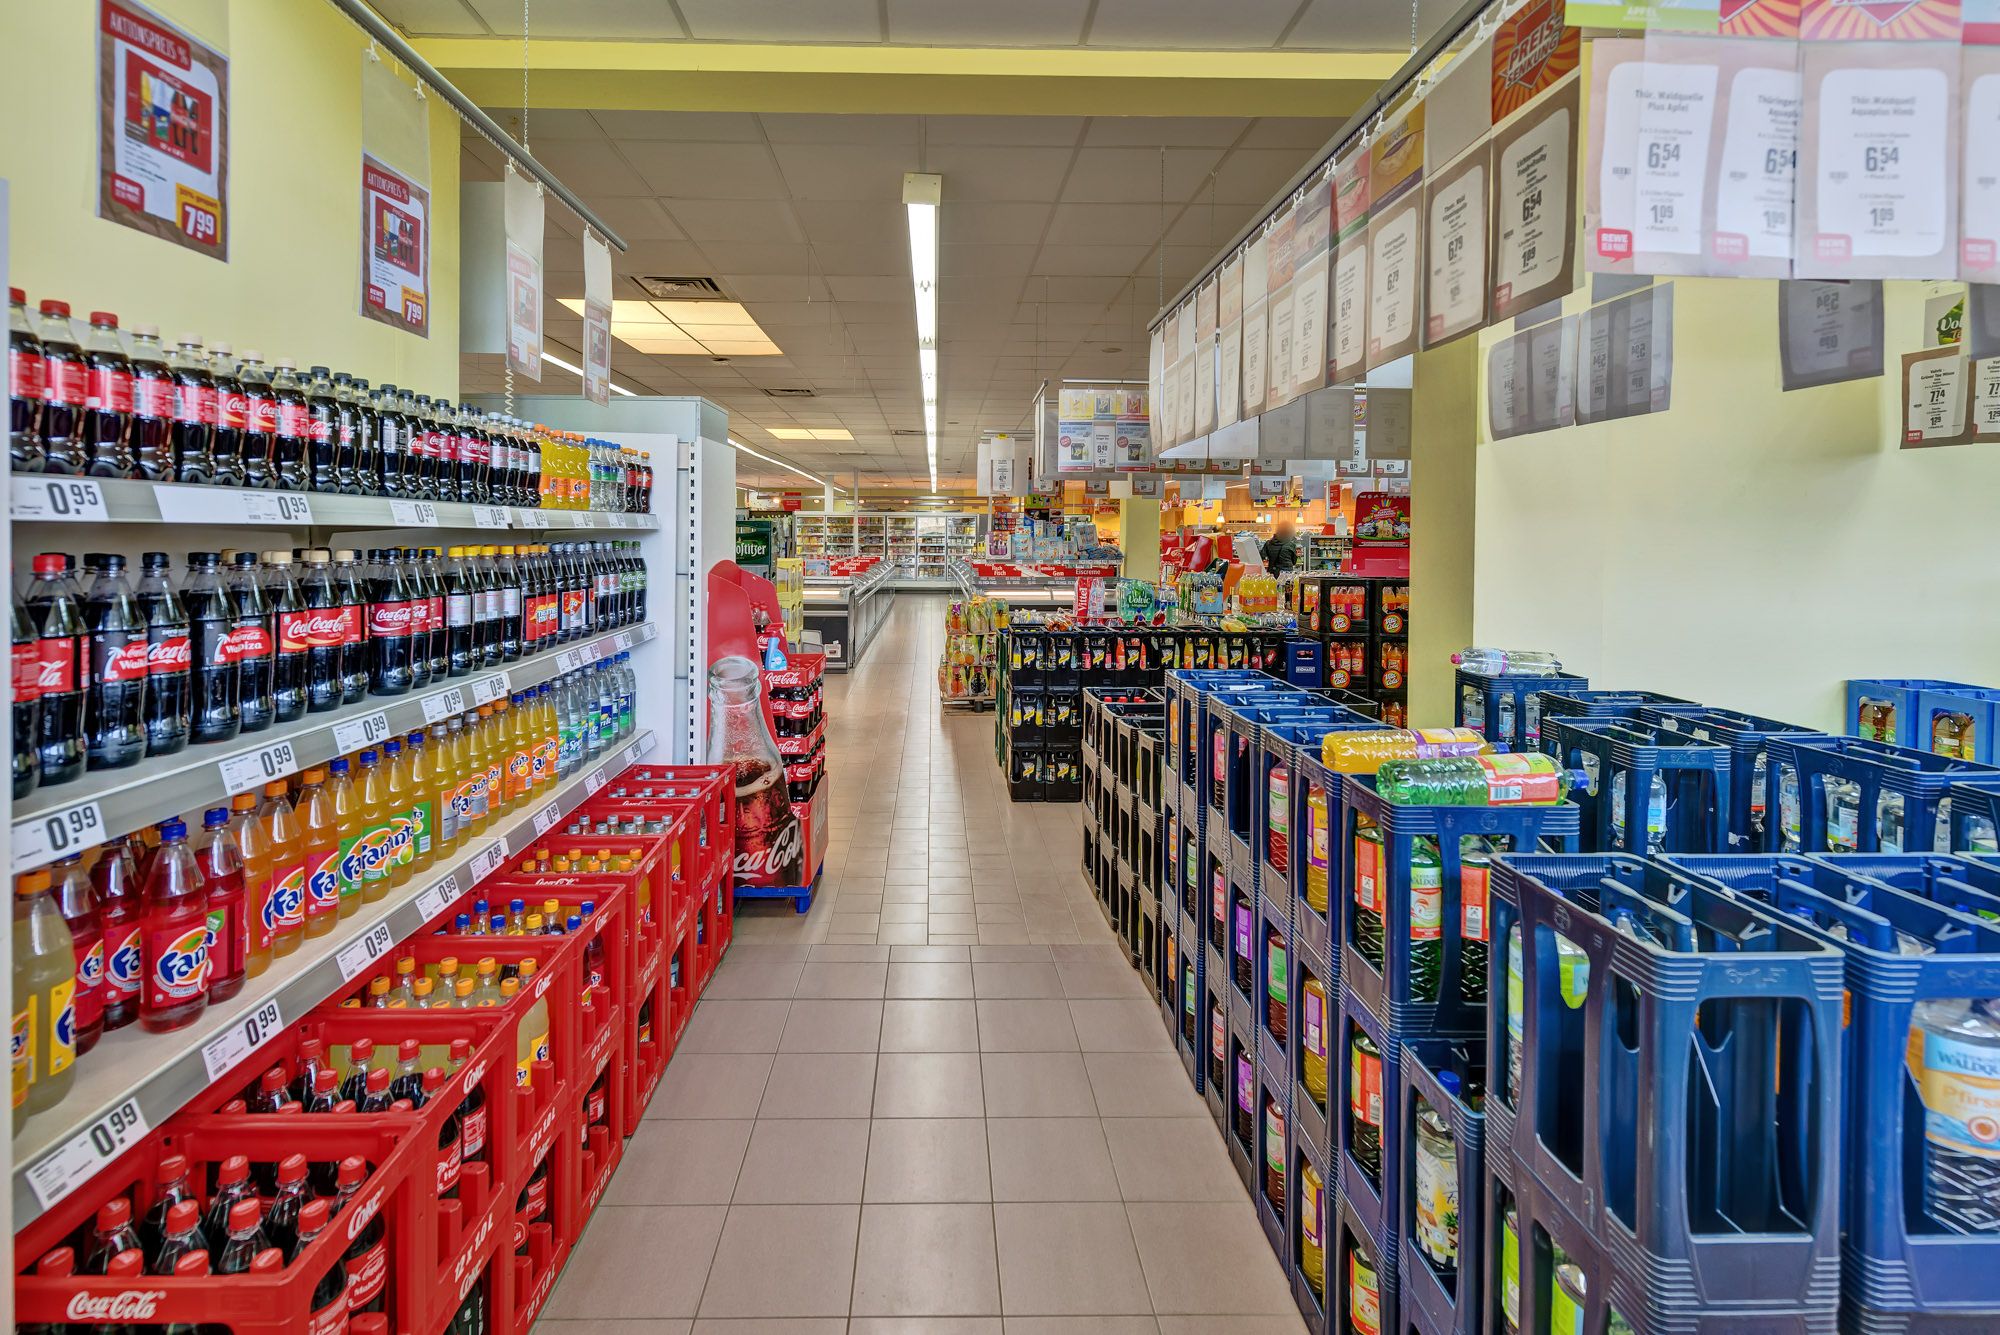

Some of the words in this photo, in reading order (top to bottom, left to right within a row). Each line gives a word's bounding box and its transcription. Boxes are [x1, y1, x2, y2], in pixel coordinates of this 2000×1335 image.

[1648, 142, 1681, 169] 6.54
[1765, 148, 1796, 175] 6.54
[1866, 146, 1898, 171] 6.54
[1522, 190, 1542, 222] 6.54
[1650, 204, 1673, 224] 1.09
[1870, 208, 1894, 227] 1.09
[184, 204, 214, 239] 7.99
[1448, 235, 1463, 261] 6.79
[1602, 233, 1628, 242] REWE
[406, 300, 422, 324] 7.99
[1930, 390, 1946, 402] 7.74
[47, 482, 98, 515] 0.95
[278, 496, 306, 520] 0.95
[415, 503, 434, 523] 0.95
[491, 508, 505, 526] 0.95
[1078, 587, 1088, 612] Vittel
[1128, 593, 1151, 605] Volvic
[490, 677, 505, 697] 0.99
[443, 691, 462, 713] 0.99
[362, 713, 387, 742] 0.99
[260, 745, 293, 777] 0.99
[46, 805, 97, 852] 0.99
[488, 844, 502, 869] 0.99
[438, 877, 457, 904] 0.99
[365, 925, 389, 958] 0.99
[245, 1004, 277, 1046] 0.99
[89, 1103, 139, 1157] 0.99
[66, 1290, 160, 1320] Coca-Cola
